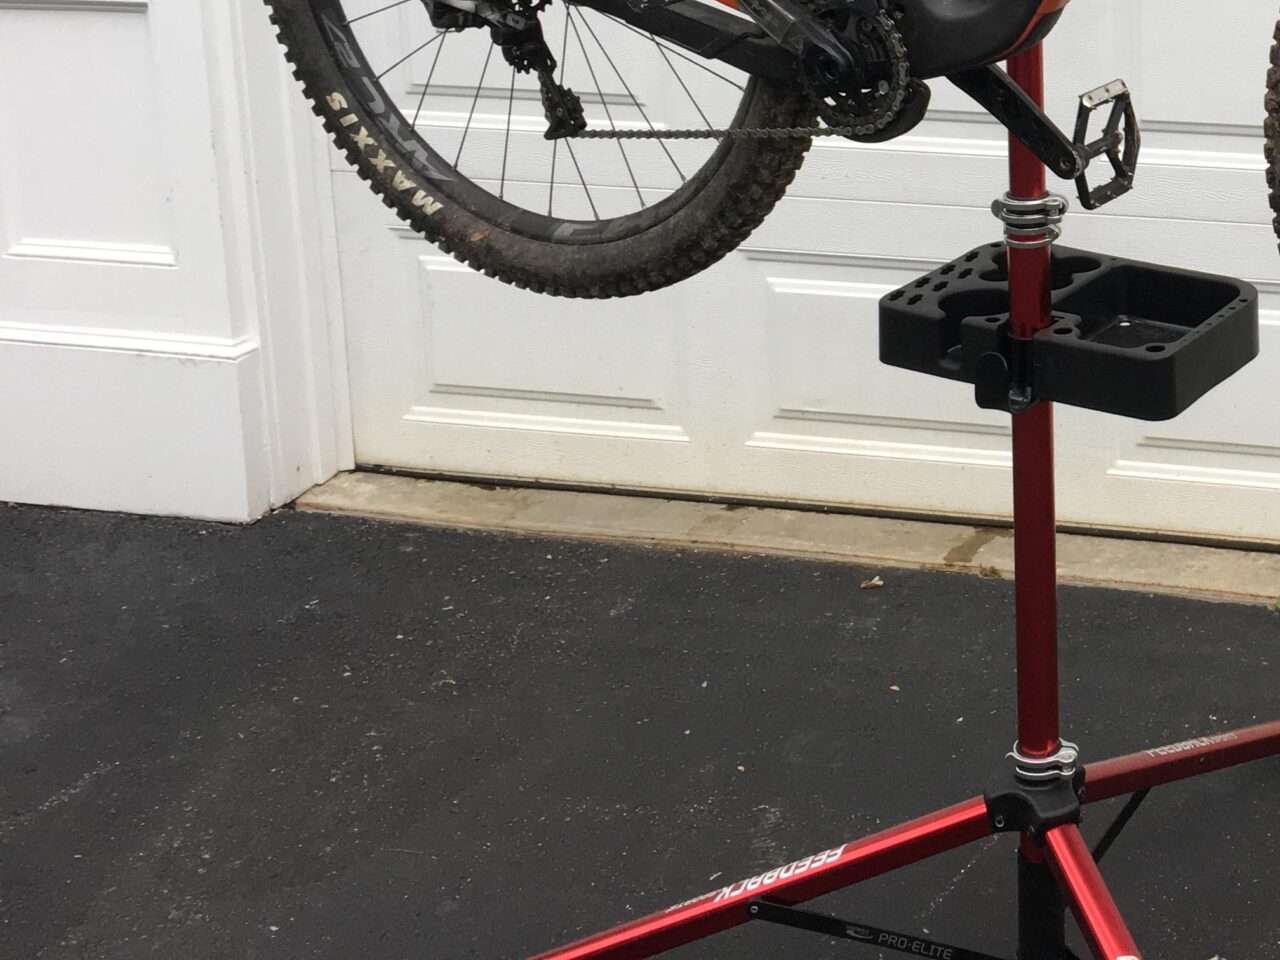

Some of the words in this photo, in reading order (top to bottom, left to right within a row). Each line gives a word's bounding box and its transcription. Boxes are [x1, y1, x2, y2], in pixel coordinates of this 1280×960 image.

[326, 90, 444, 216] MAXXIS
[714, 843, 847, 904] FEEDBACK
[878, 933, 953, 960] PRO-ELITE
